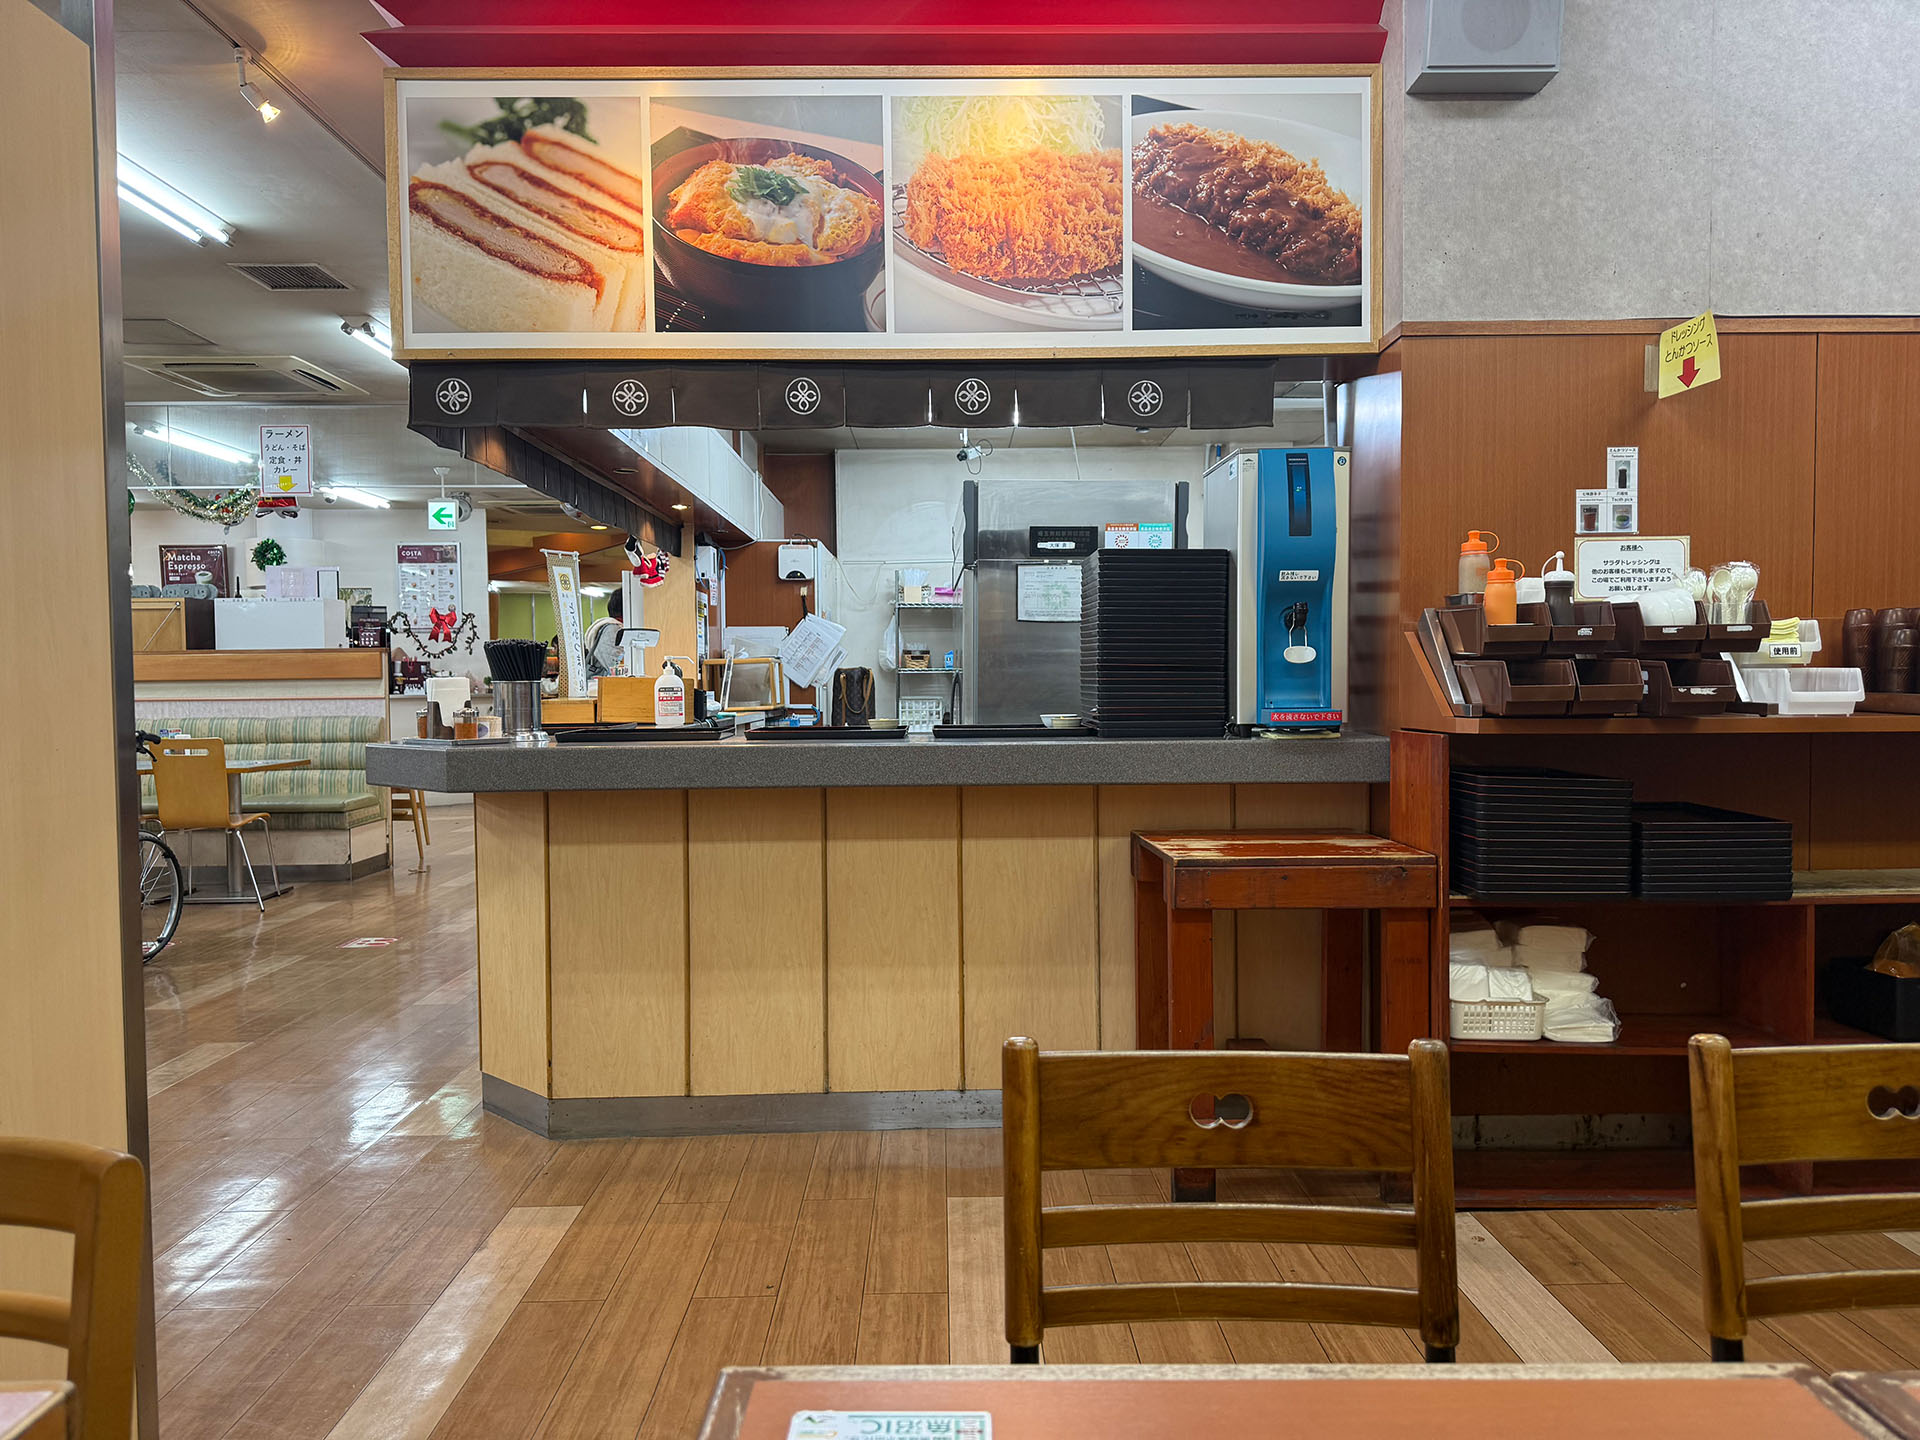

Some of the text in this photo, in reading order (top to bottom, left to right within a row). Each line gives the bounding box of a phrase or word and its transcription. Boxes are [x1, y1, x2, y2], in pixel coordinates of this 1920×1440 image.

[1671, 316, 1705, 344] ドレッシング
[1665, 333, 1713, 363] とんかつソース
[265, 429, 304, 439] ラーメン
[264, 443, 306, 452] うどん・そば
[268, 455, 302, 465] 定食・丼
[273, 466, 298, 474] カレー
[1620, 544, 1644, 552] お客様へ
[168, 552, 201, 561] Matcha
[168, 561, 206, 573] Espresso
[1773, 646, 1798, 656] 使用前
